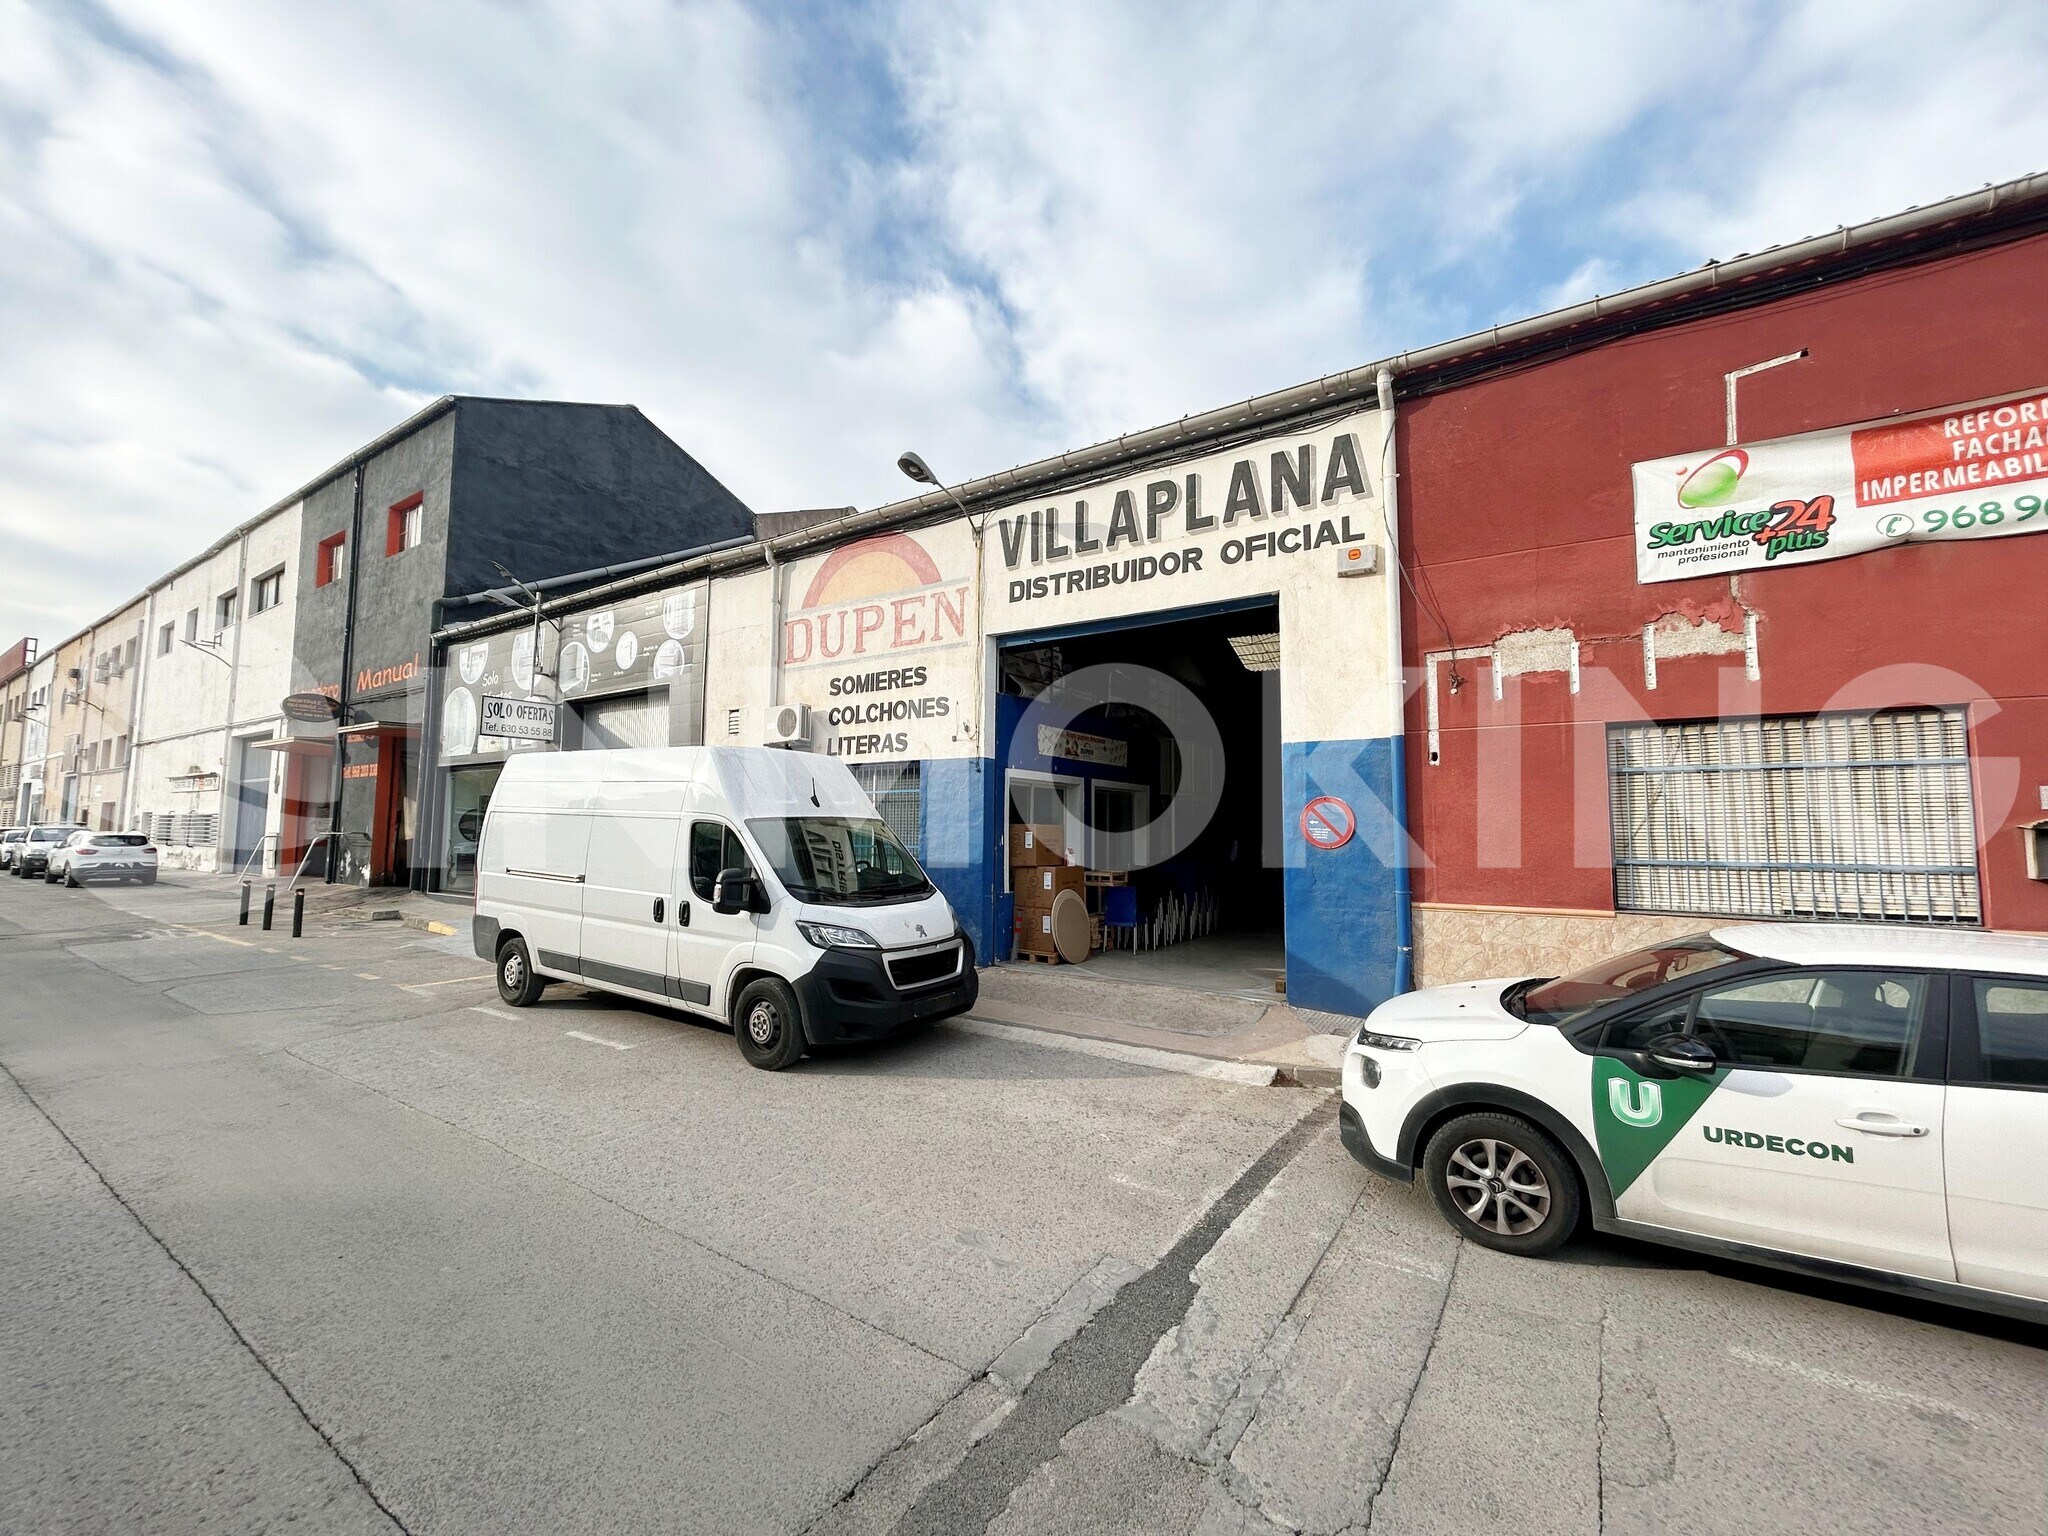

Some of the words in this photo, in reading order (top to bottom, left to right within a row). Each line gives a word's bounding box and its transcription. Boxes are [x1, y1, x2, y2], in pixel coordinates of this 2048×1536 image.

[1952, 425, 2048, 461] FACHA
[1862, 452, 2048, 501] IMPERMEABIL
[999, 433, 1373, 570] VILLAPLANA
[1922, 501, 2005, 533] 968
[2014, 495, 2048, 522] 9
[1647, 509, 1773, 550] Service
[1772, 494, 1836, 534] 24
[1009, 547, 1202, 603] DISTRIBUIDOR
[1220, 516, 1365, 564] OFICIAL
[1657, 539, 1750, 559] mantenimiento
[1678, 547, 1749, 566] profesional
[784, 587, 969, 664] DUPEN
[356, 652, 419, 693] Manual
[482, 670, 499, 686] Solo
[829, 666, 927, 696] SOMIERES
[484, 702, 513, 719] SOLO
[517, 705, 554, 725] OFERTAS
[828, 697, 949, 725] COLCHONES
[484, 722, 499, 732] Tef.
[501, 724, 517, 734] 630
[519, 726, 529, 735] 53
[530, 727, 541, 736] 55
[542, 728, 553, 737] 88
[827, 733, 908, 756] LITERAS
[1608, 1077, 1662, 1128] U
[1703, 1126, 1854, 1163] URDECON
